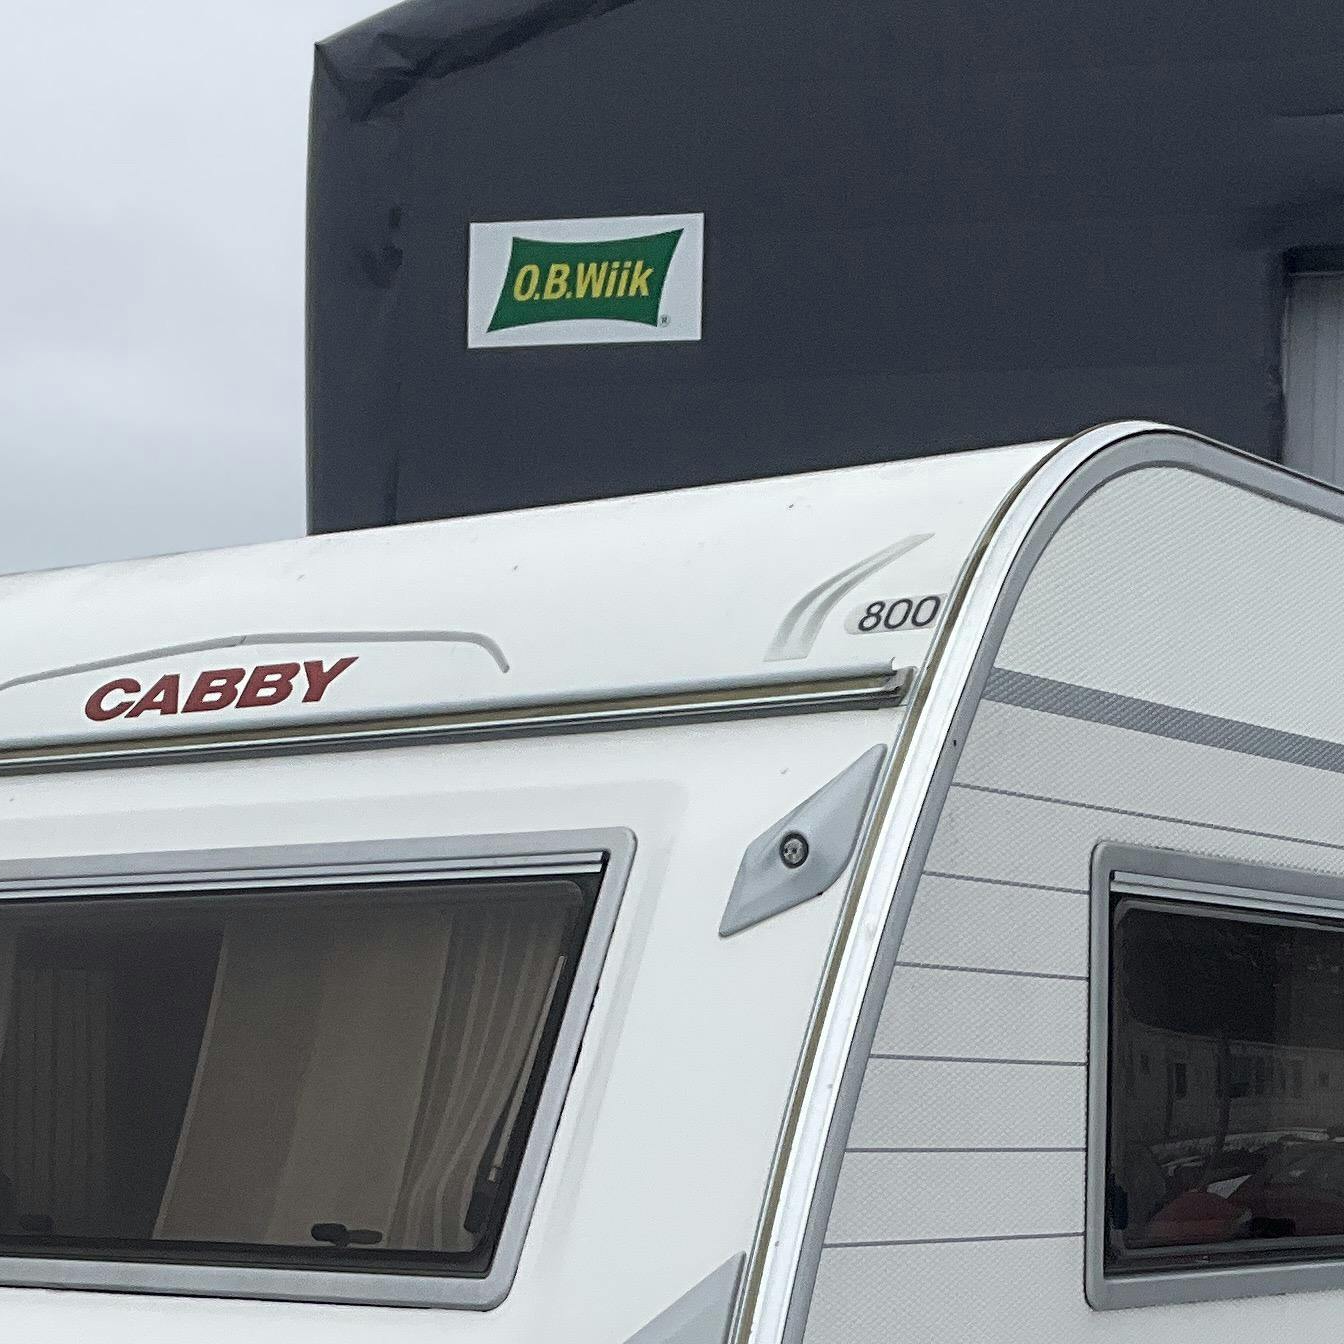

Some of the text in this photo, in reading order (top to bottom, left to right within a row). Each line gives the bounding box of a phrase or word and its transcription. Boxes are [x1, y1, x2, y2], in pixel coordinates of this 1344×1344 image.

[513, 260, 655, 302] O.B.Wiik
[858, 595, 942, 632] 800
[84, 656, 360, 722] CABBY
